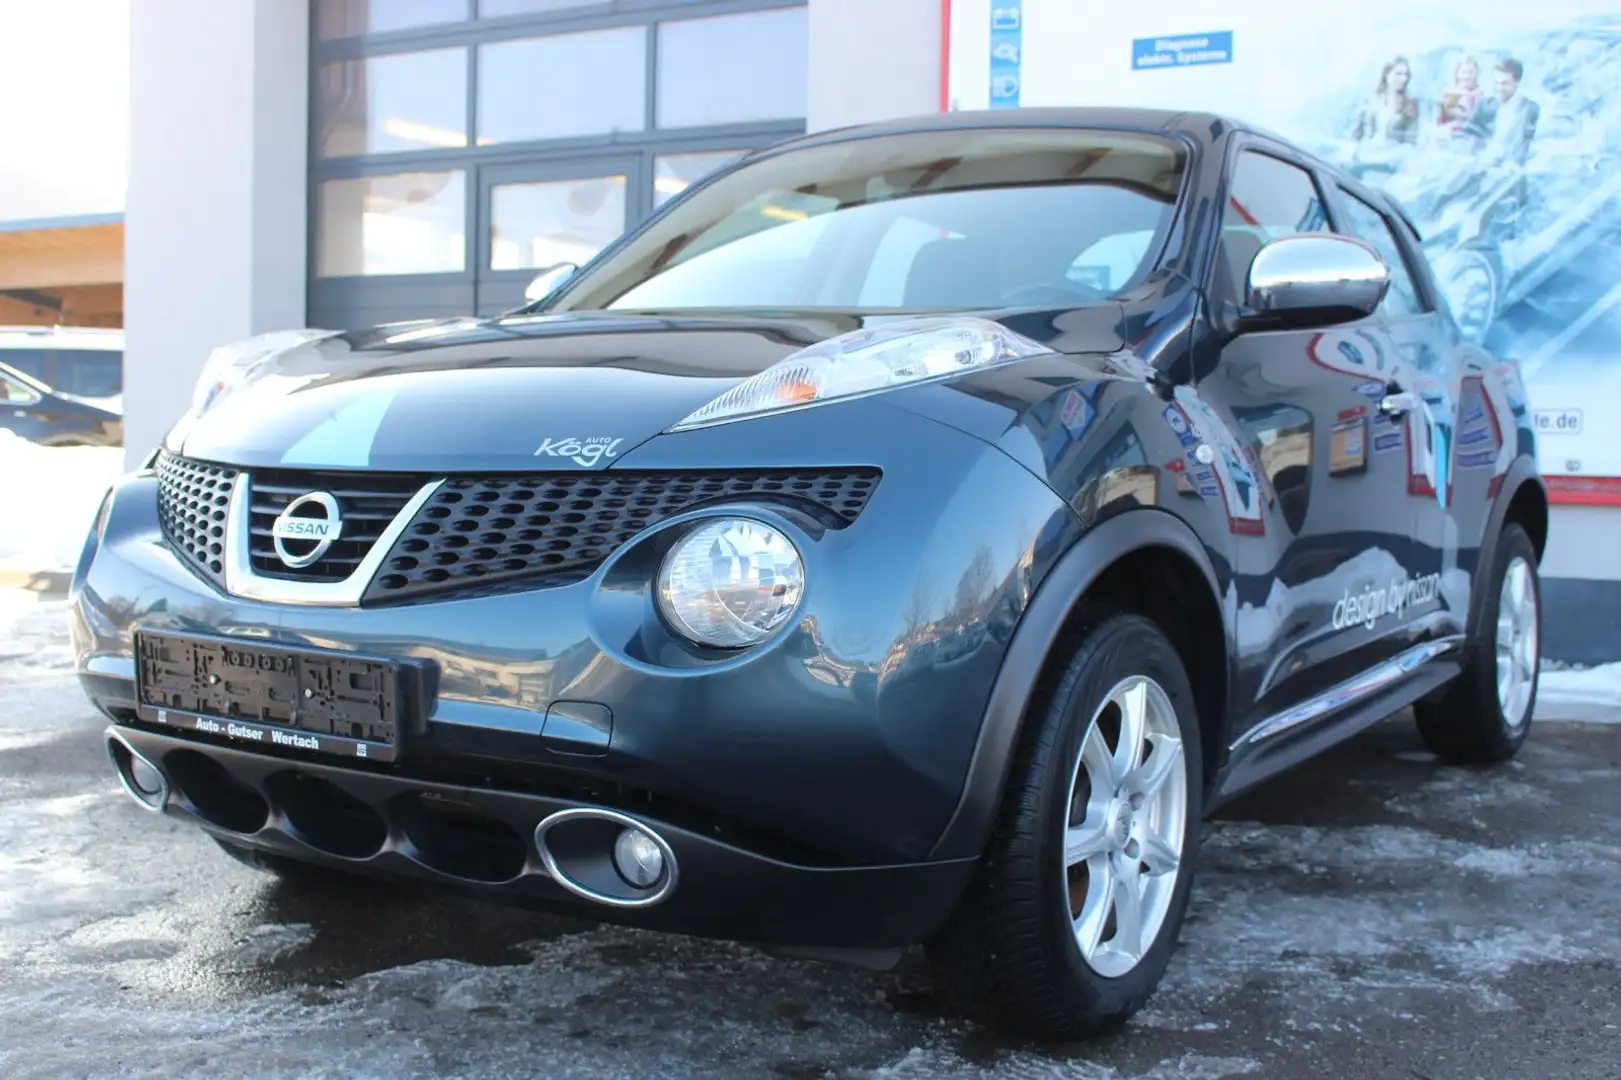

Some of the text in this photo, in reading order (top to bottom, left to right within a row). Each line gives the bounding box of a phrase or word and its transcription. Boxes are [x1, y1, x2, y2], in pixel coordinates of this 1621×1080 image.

[533, 437, 625, 467] Kögl
[277, 521, 330, 536] ISSAN
[1333, 583, 1386, 630] design
[196, 717, 220, 734] Auto
[227, 722, 264, 742] Gutser
[271, 730, 320, 750] Wertach
